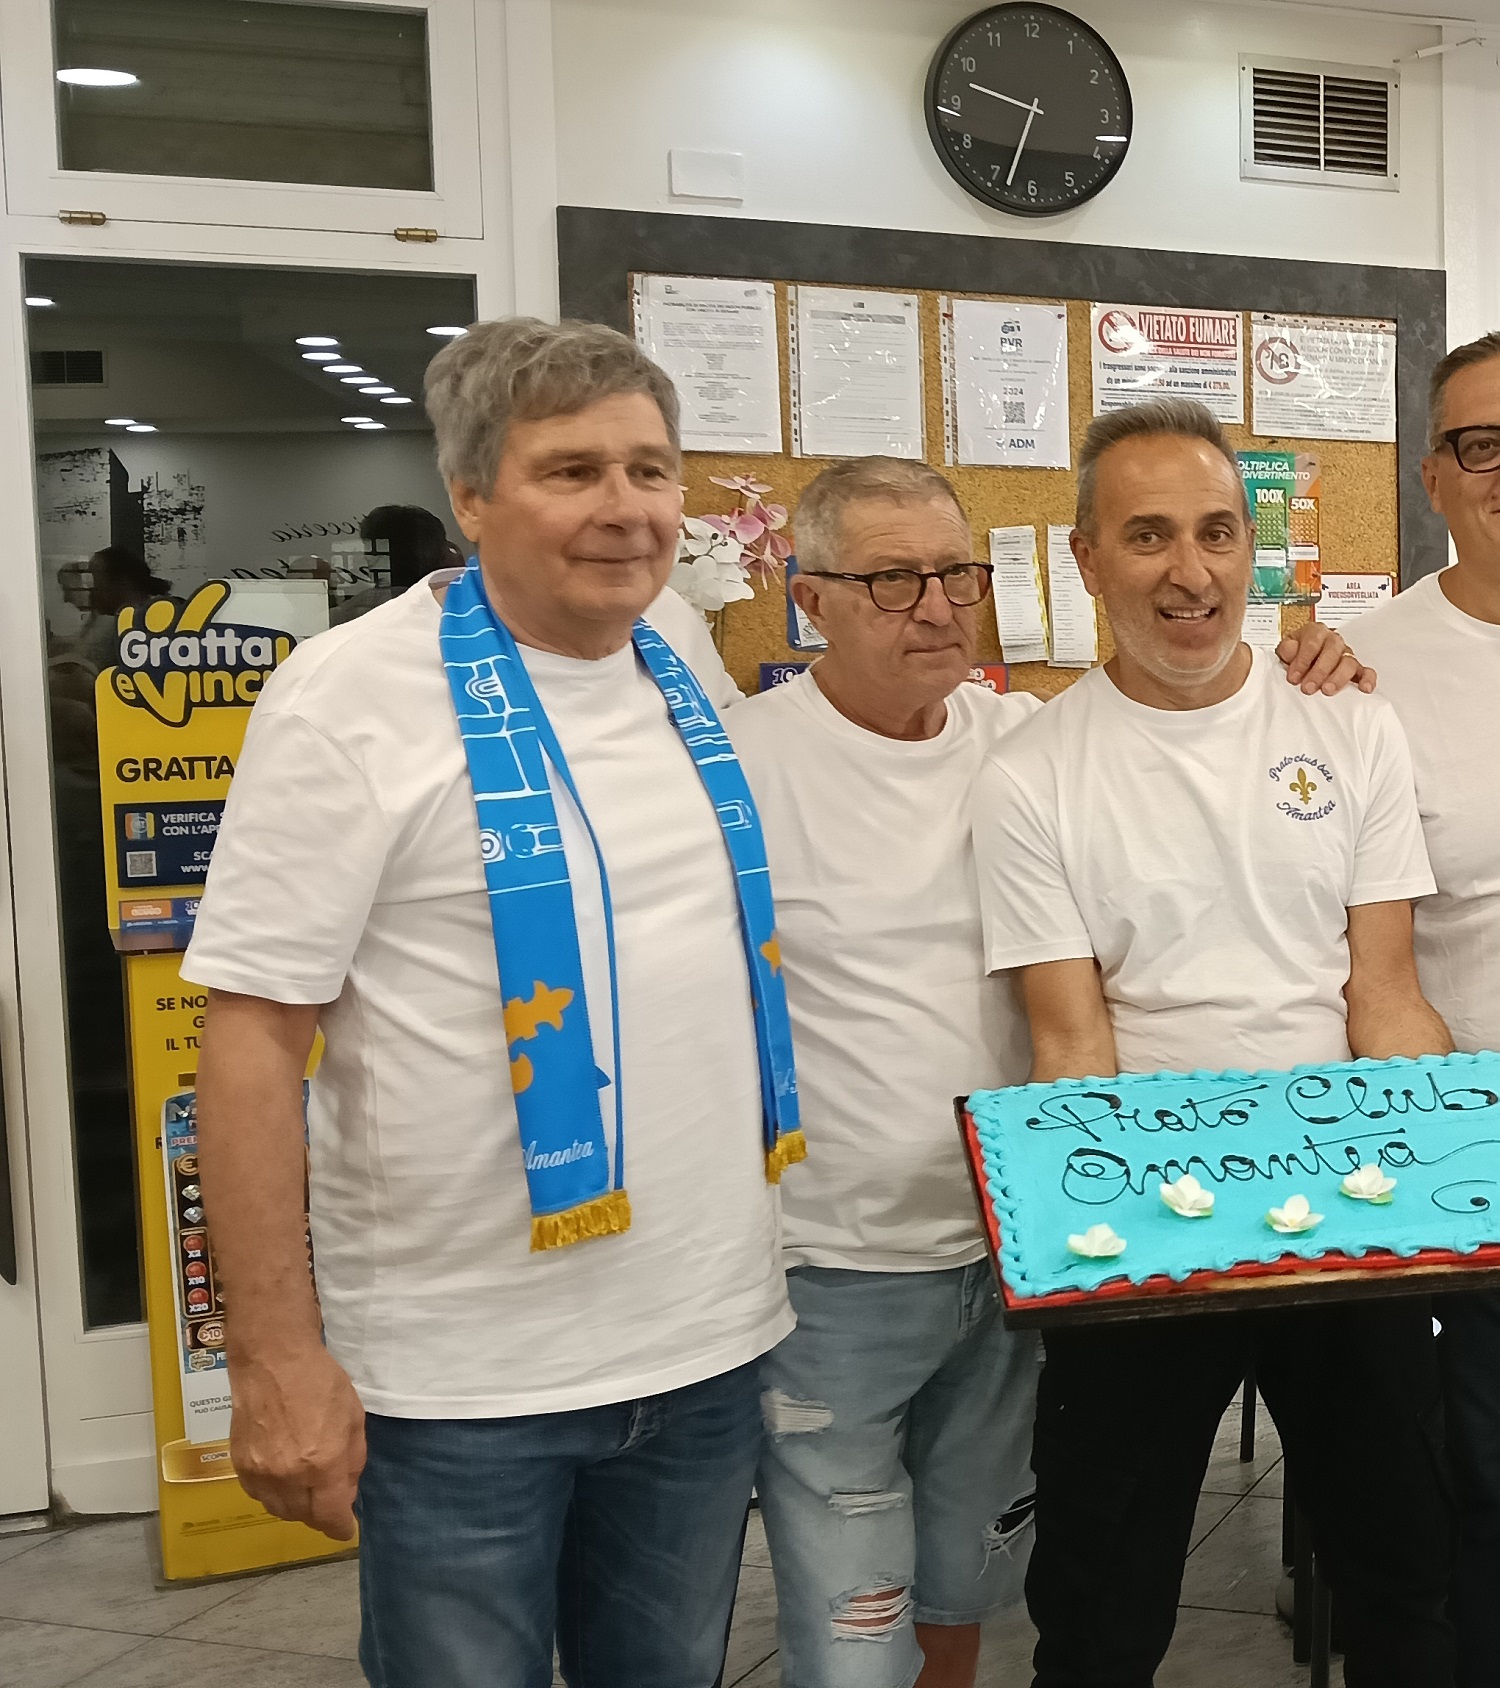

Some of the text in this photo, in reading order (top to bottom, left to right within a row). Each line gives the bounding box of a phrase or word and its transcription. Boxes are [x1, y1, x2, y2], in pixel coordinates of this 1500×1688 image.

[1024, 23, 1040, 38] 12
[987, 31, 1001, 47] 11
[1067, 40, 1074, 54] 1
[960, 56, 976, 73] 10
[1089, 69, 1099, 85] 2
[951, 95, 961, 110] 9
[1100, 109, 1109, 124] 3
[962, 133, 972, 149] 8
[1092, 146, 1102, 161] 4
[990, 165, 1000, 180] 7
[1064, 171, 1075, 187] 5
[1027, 180, 1038, 196] 6
[1140, 314, 1236, 346] VIETATO FUMARE
[1000, 337, 1023, 347] PVR
[1003, 387, 1024, 396] 2024
[1008, 438, 1035, 449] ADM
[1242, 471, 1310, 481] DIVERTIMENTO
[1256, 489, 1285, 503] 100X
[1291, 498, 1316, 510] 50X
[116, 673, 136, 700] e
[116, 755, 235, 782] GRATTA
[1269, 756, 1294, 782] Prato
[161, 812, 216, 823] VERIFICA
[1276, 800, 1336, 821] Amantea
[162, 826, 189, 836] CON
[156, 997, 175, 1011] SE
[166, 1037, 179, 1051] IL
[1026, 1071, 1500, 1141] Prato Club
[190, 1397, 221, 1408] QUESTO
